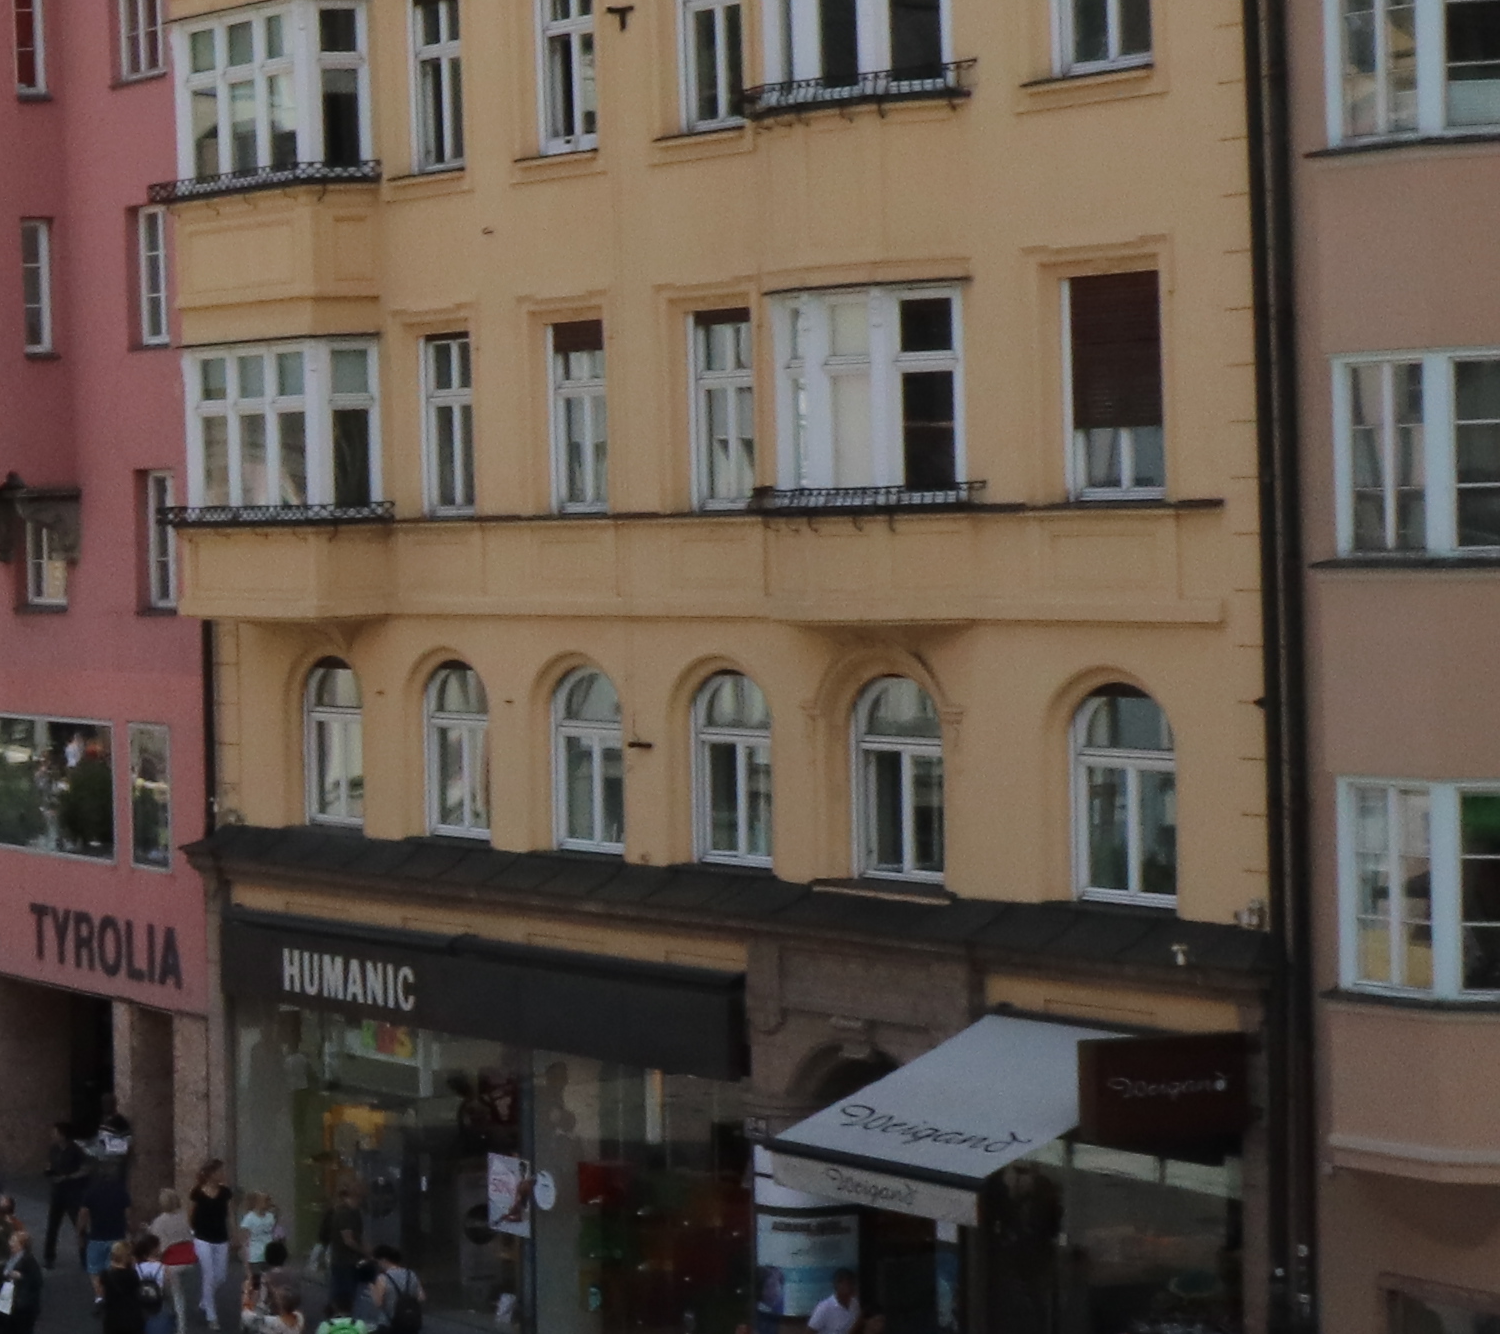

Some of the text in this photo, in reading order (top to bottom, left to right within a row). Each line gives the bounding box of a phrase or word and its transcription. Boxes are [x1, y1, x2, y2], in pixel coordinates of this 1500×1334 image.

[29, 901, 183, 990] TYROLIA
[281, 947, 416, 1012] HUMANIC
[840, 1104, 1030, 1152] Weigand
